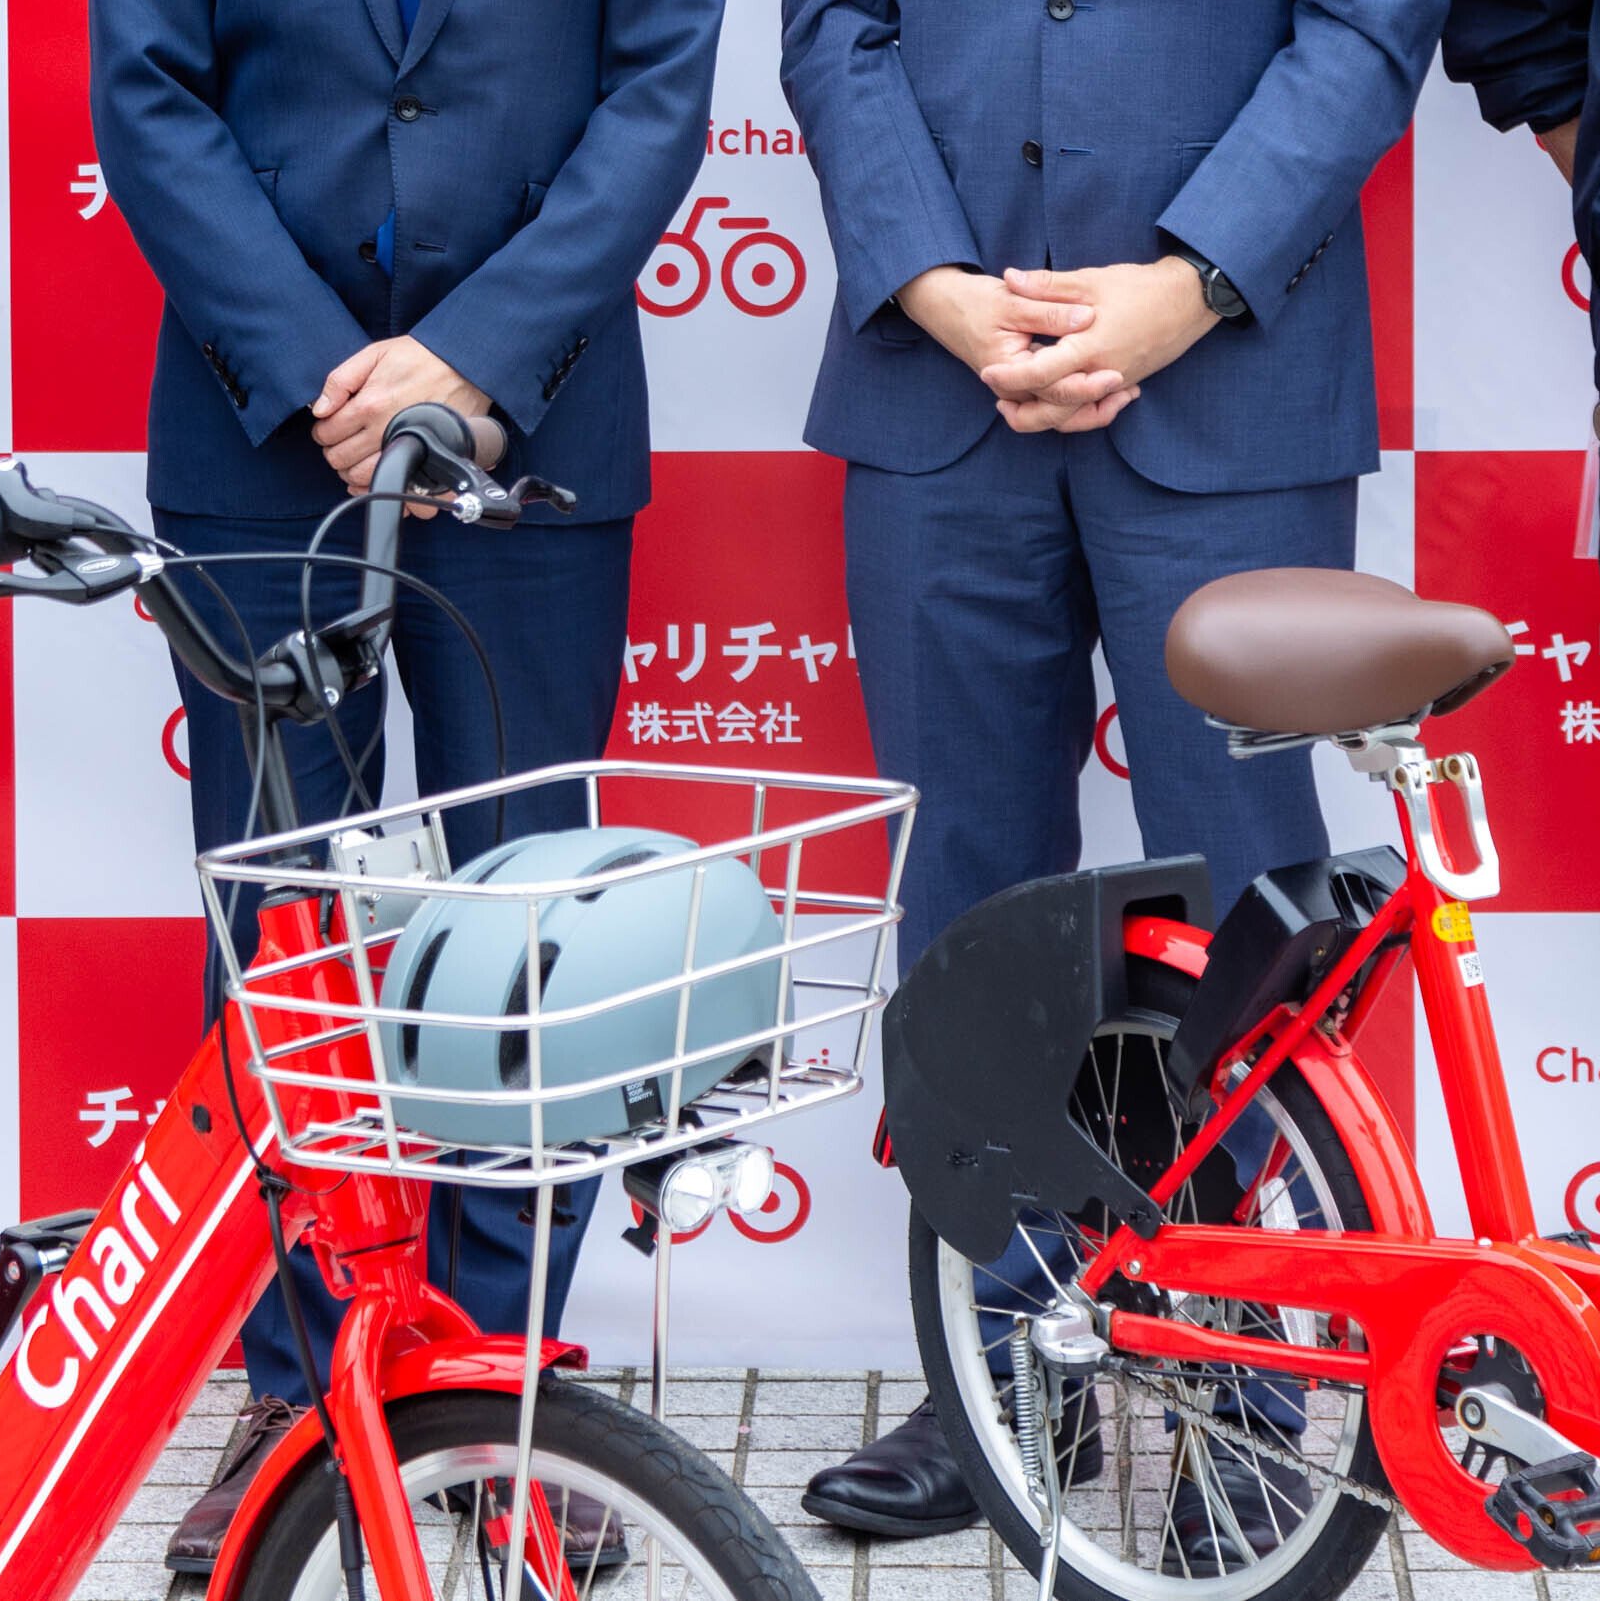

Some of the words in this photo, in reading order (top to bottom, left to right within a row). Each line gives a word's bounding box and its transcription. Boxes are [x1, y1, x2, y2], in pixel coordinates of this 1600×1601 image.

[627, 701, 803, 744] 株式会社
[15, 1140, 182, 1409] Chari
